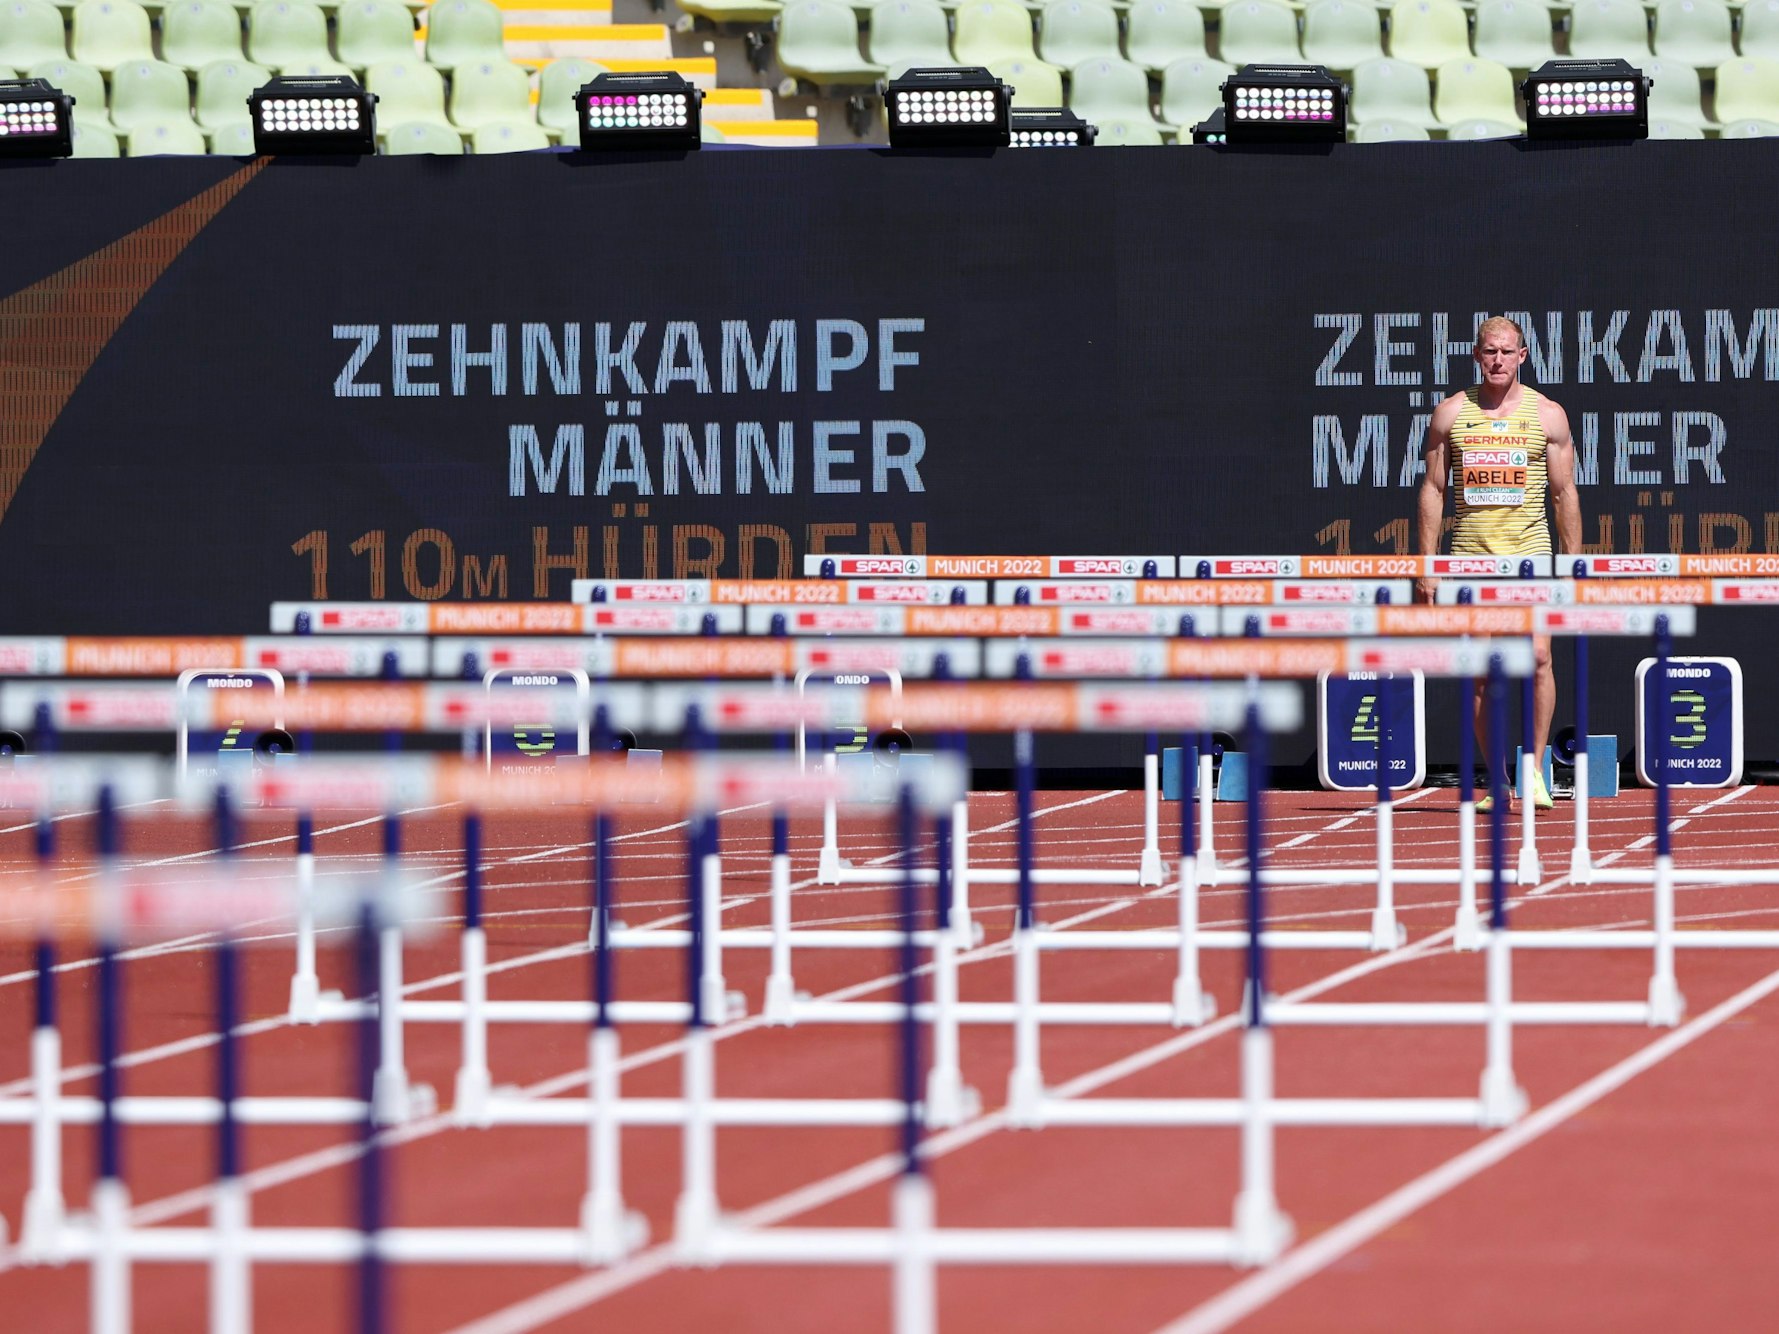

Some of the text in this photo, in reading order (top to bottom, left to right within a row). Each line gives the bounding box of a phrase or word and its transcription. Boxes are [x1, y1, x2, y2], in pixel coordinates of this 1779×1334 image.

[332, 318, 926, 398] ZEHNKAMPF
[1463, 435, 1528, 445] GERMANY
[507, 400, 928, 497] MÄNNER
[1465, 452, 1509, 464] SPAR
[1466, 471, 1524, 485] ABELE
[1467, 494, 1521, 503] MUNICH 2022
[856, 560, 1120, 574] SPAR MUNICH 2022 SPAR
[1231, 560, 1495, 574] SPAR MUNICH 2022 SPAR
[1608, 560, 1655, 572] SPAR
[1688, 558, 1751, 572] MUNICH
[718, 584, 789, 601] MUNICH
[795, 584, 840, 601] 2022
[1143, 585, 1215, 602] MUNICH
[1220, 585, 1265, 602] 2022
[1583, 585, 1655, 603] MUNICH
[1660, 585, 1705, 603] 2022
[834, 675, 870, 685] ONDO
[1666, 668, 1711, 678] MONDO
[207, 678, 253, 688] MONDO
[512, 676, 558, 686] MONDO
[1351, 696, 1393, 750] 4
[1669, 689, 1707, 749] 3
[1338, 761, 1378, 771] MUNICH
[1697, 759, 1722, 769] 2022
